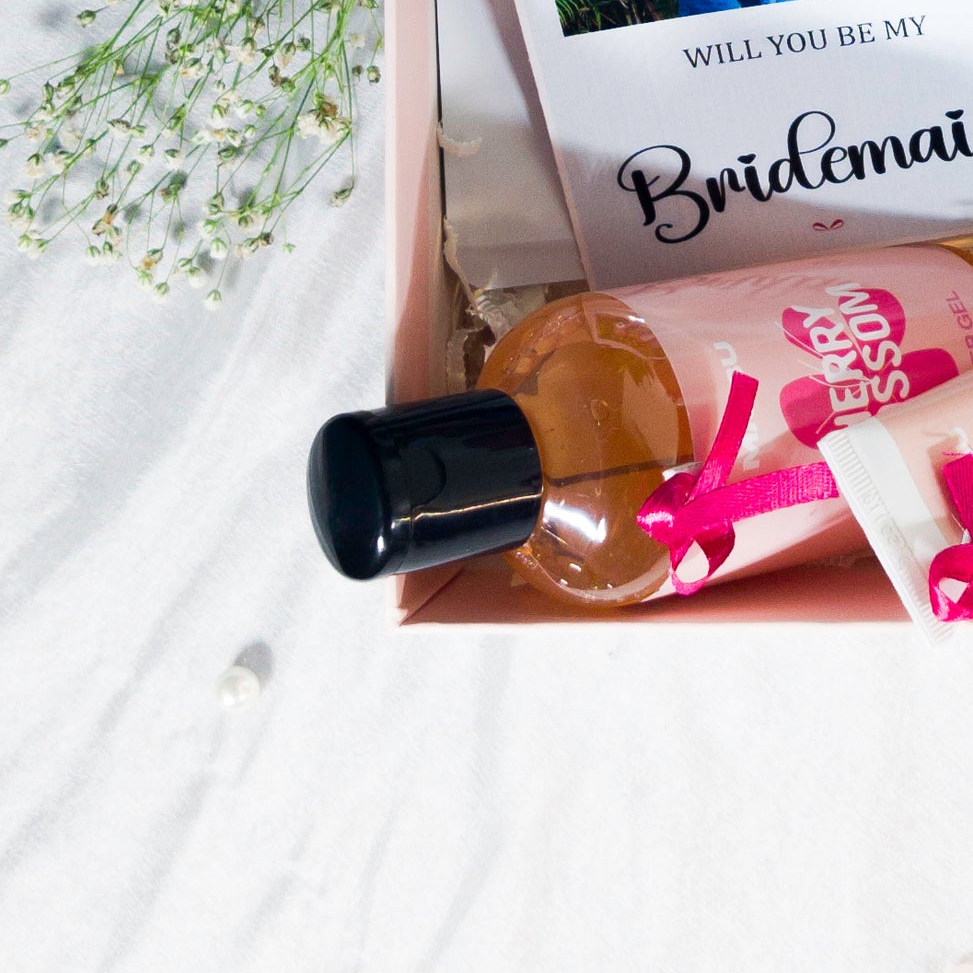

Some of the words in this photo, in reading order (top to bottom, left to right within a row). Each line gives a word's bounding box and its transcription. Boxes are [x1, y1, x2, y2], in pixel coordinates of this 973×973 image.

[683, 43, 763, 68] WILL
[767, 30, 829, 57] YOU
[839, 22, 876, 47] BE
[884, 15, 928, 39] MY
[825, 282, 911, 404] SSOM
[945, 290, 973, 331] GEL
[791, 304, 873, 427] ERRY
